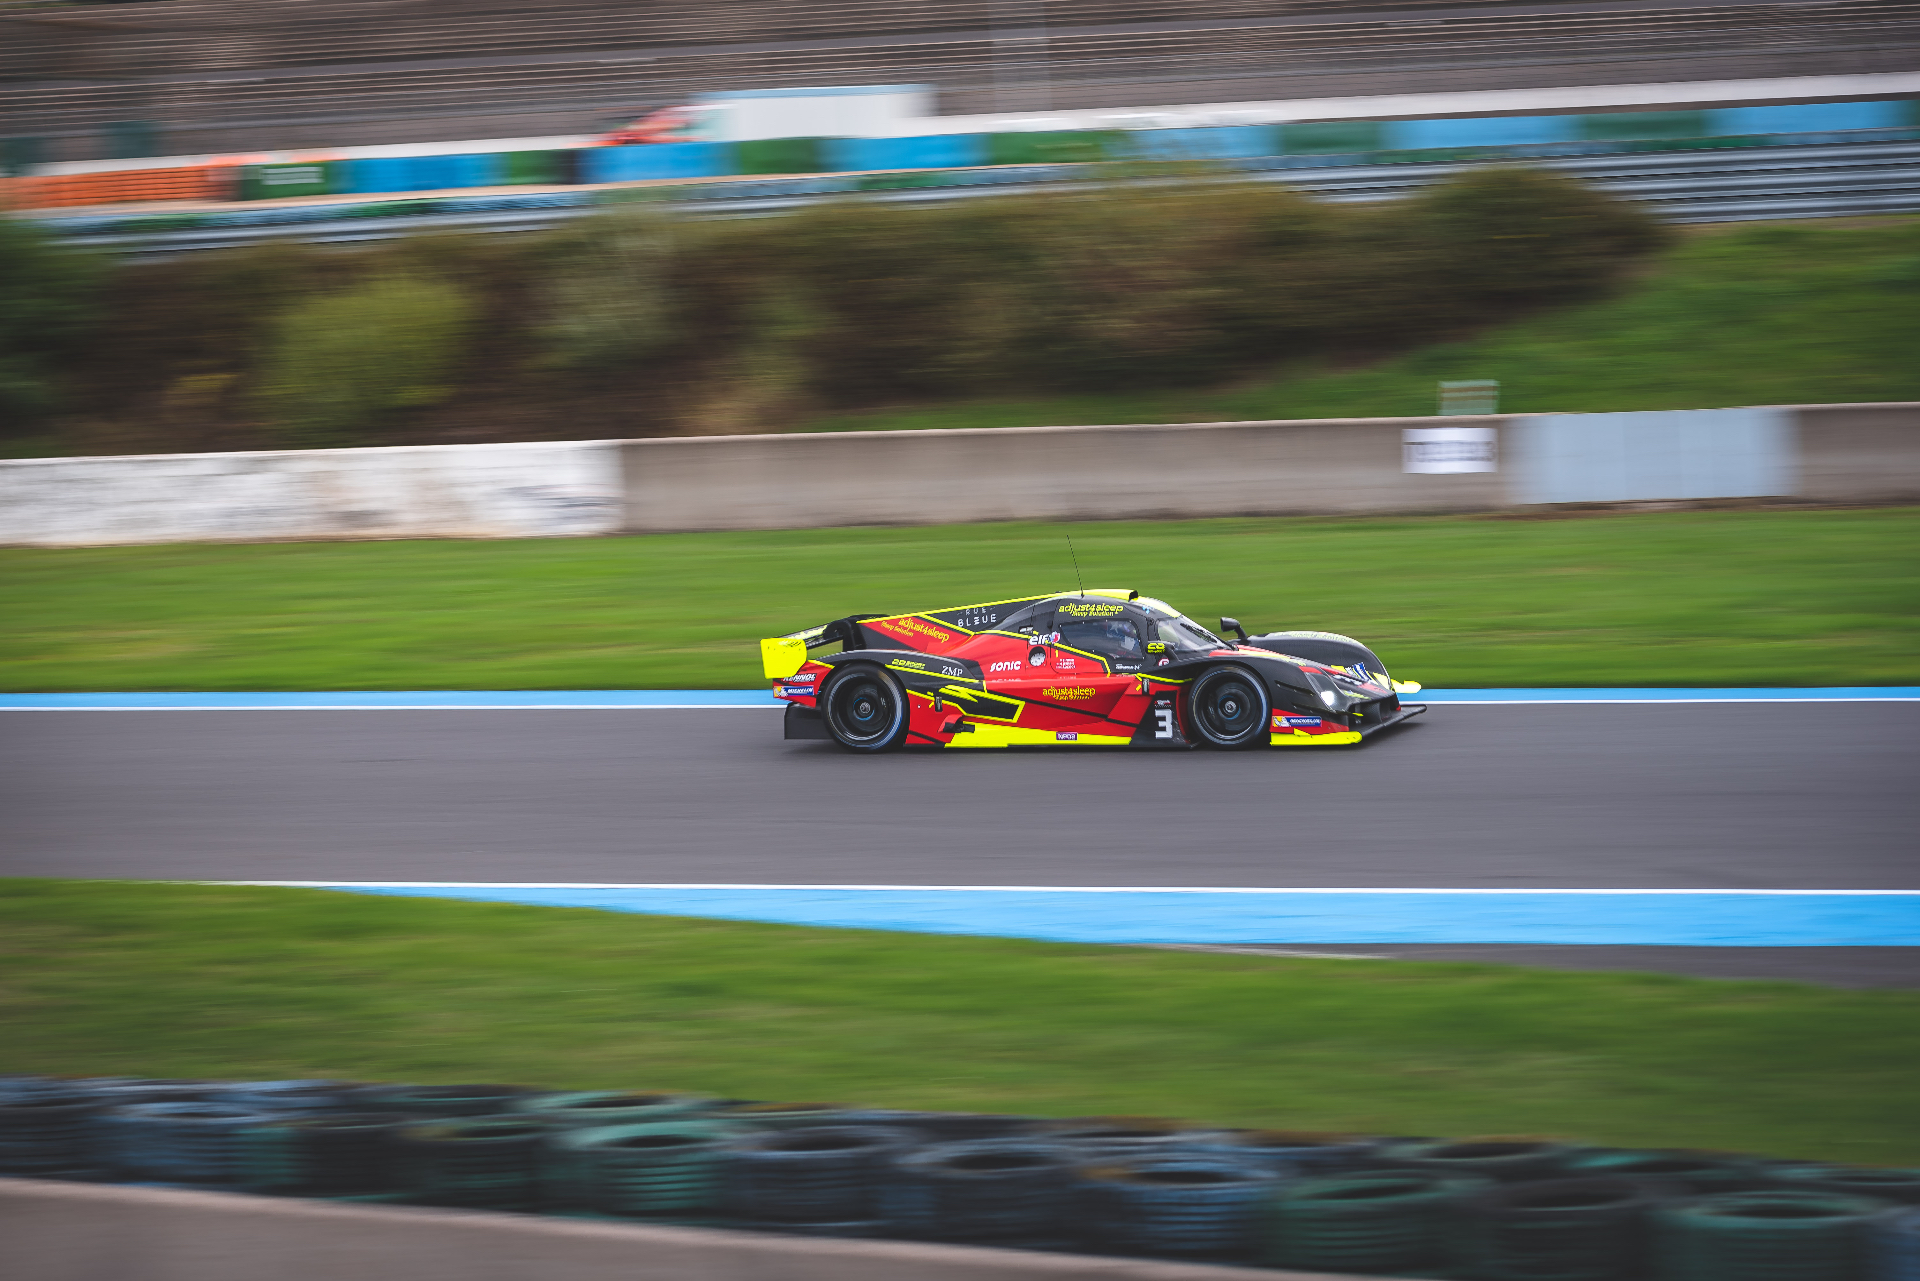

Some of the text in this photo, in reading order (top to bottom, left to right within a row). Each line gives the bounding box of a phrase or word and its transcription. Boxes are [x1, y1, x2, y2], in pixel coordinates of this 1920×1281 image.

[965, 606, 987, 616] RUE
[1059, 603, 1124, 615] adjust4sleep
[898, 617, 950, 643] adjust4sleep
[1029, 634, 1047, 646] elf
[941, 665, 963, 677] ZMP
[1043, 686, 1096, 699] adjust4sleep
[1154, 708, 1173, 739] 3
